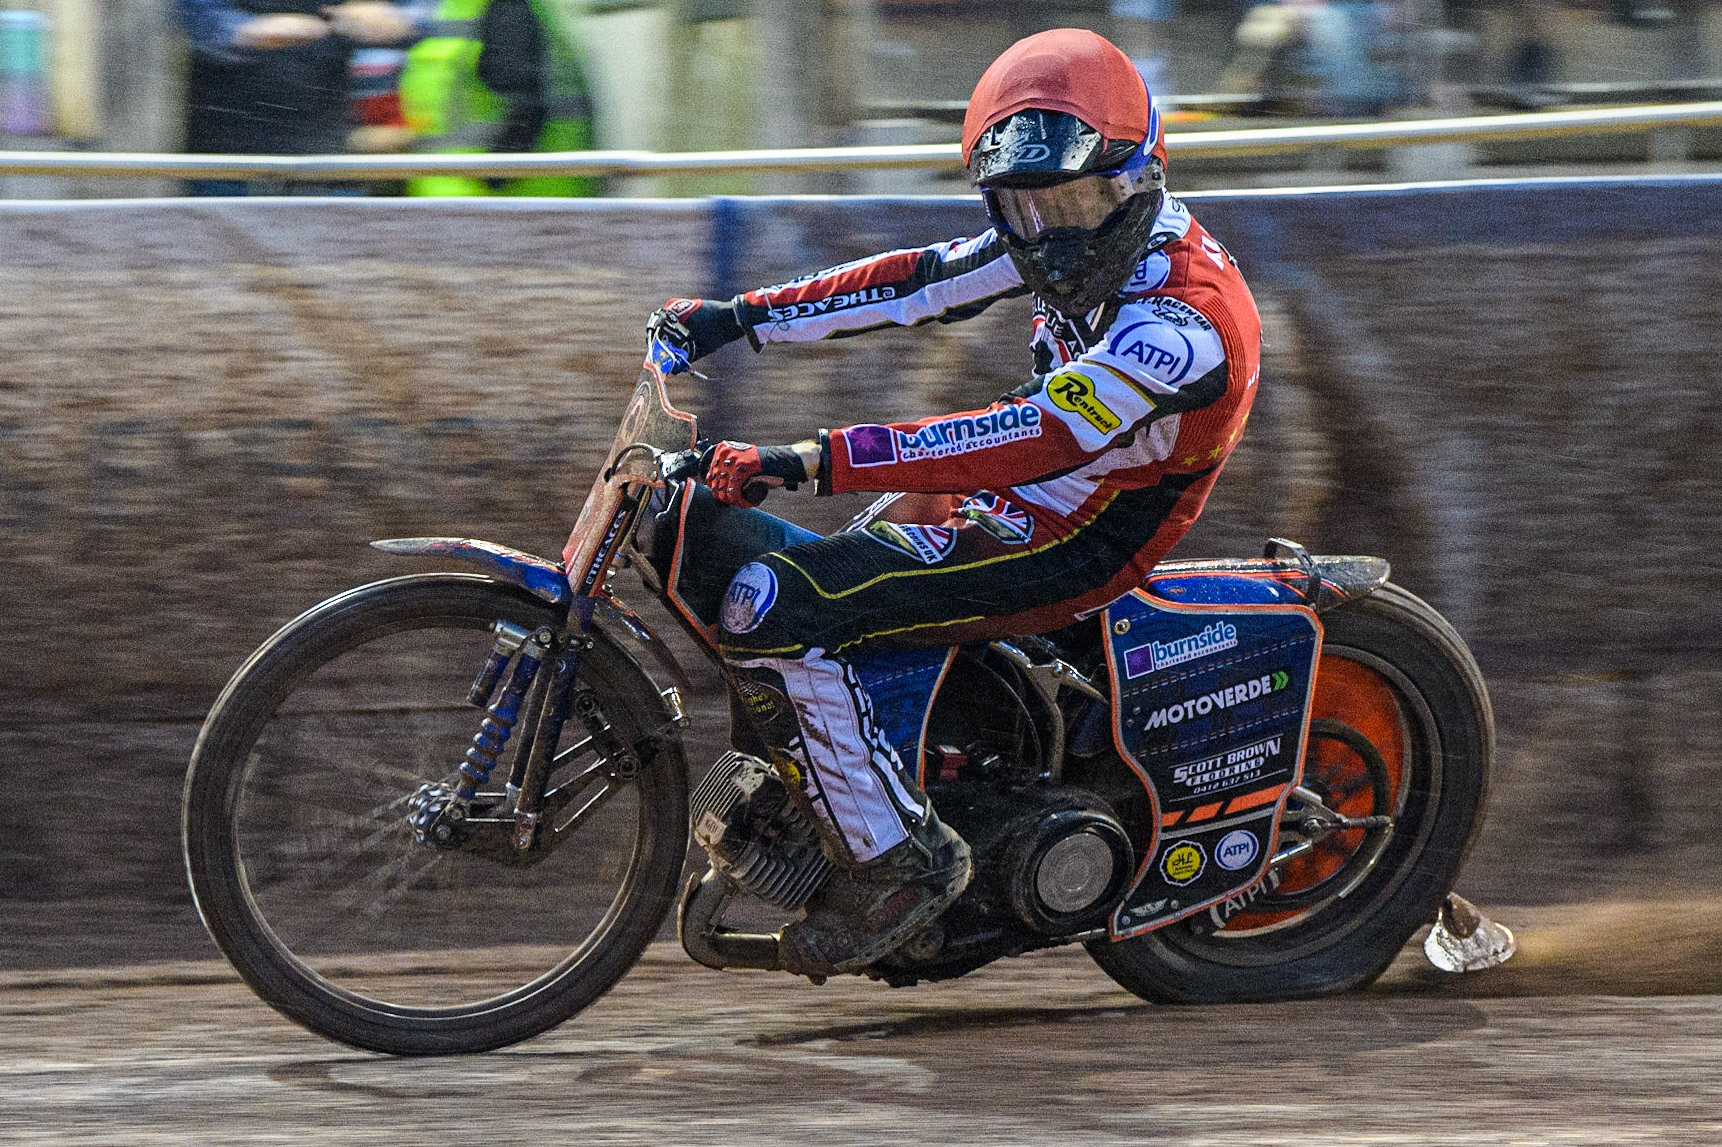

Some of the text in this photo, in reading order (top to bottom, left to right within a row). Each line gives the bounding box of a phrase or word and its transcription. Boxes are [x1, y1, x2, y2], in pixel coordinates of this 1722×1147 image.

[1121, 340, 1181, 375] ATPI
[900, 403, 1040, 449] burnside
[964, 428, 1041, 450] accountants
[1153, 622, 1236, 662] burnside
[1144, 676, 1272, 731] MOTOVERDE
[1173, 737, 1281, 784] SCOTT BROWN
[1224, 843, 1250, 858] ATPI
